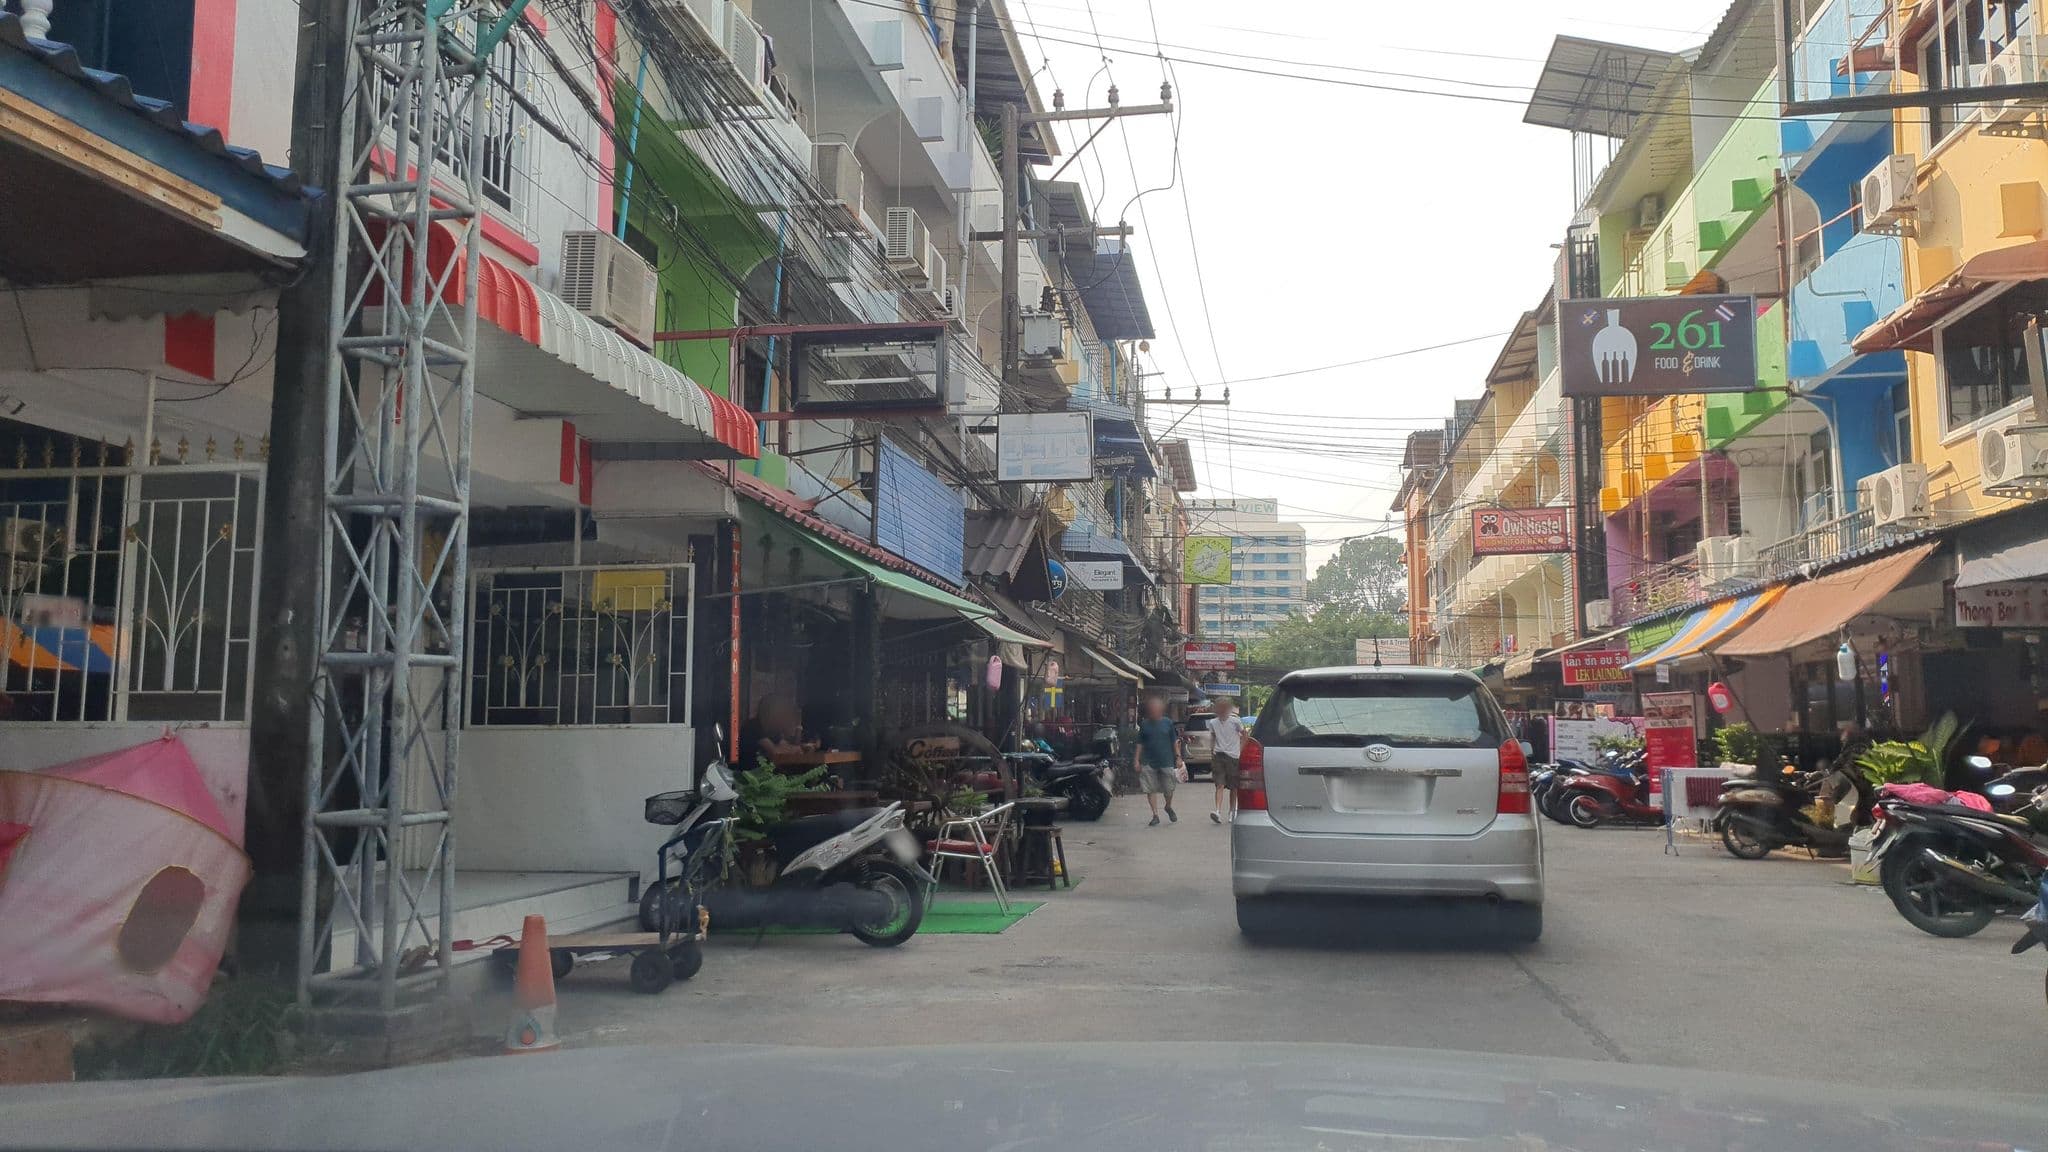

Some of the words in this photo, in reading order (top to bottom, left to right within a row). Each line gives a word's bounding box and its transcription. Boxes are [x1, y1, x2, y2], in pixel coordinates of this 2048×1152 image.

[1649, 309, 1725, 349] 261
[1655, 356, 1679, 369] FOOD
[1682, 350, 1695, 376] &
[1694, 356, 1721, 369] DRINK
[1502, 517, 1523, 536] Owl
[1526, 514, 1562, 536] Hostel
[1575, 669, 1590, 681] LEK
[1591, 667, 1628, 681] LAUNDRY
